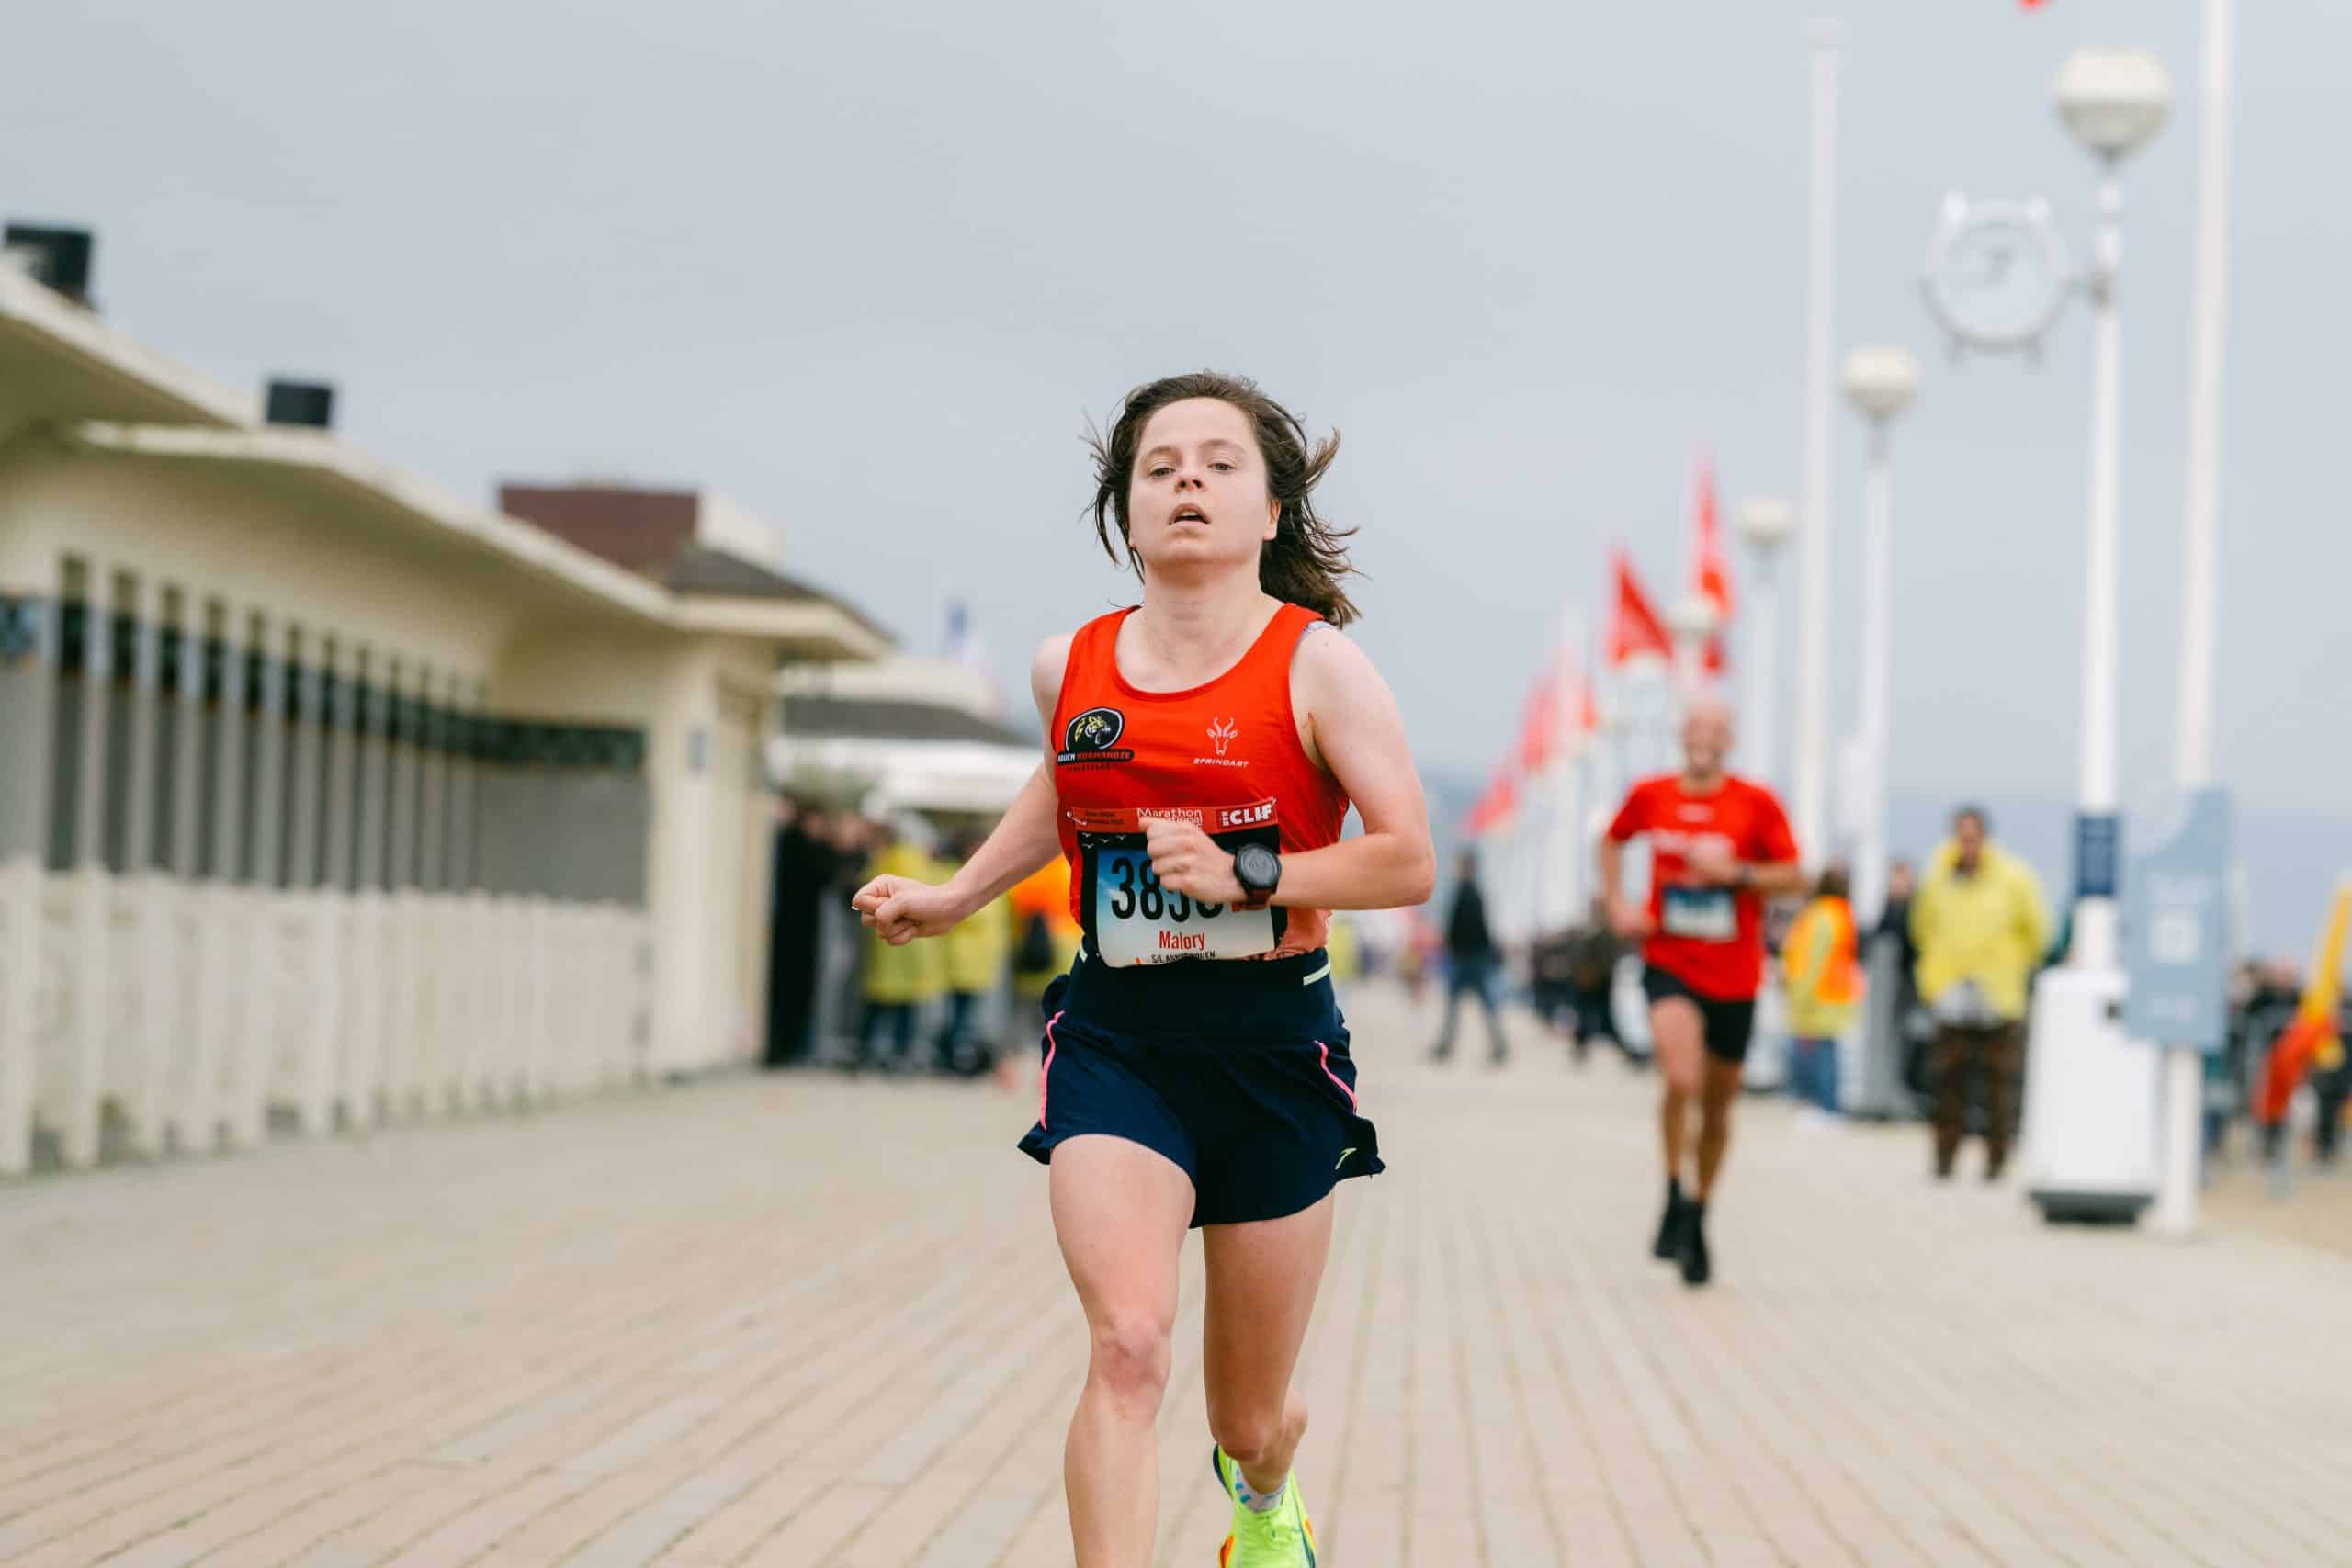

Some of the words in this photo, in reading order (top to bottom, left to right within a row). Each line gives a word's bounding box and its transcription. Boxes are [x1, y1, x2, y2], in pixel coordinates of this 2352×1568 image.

[1137, 807, 1203, 818] Marathon
[1230, 803, 1272, 825] CLIF
[1159, 930, 1205, 951] Malory
